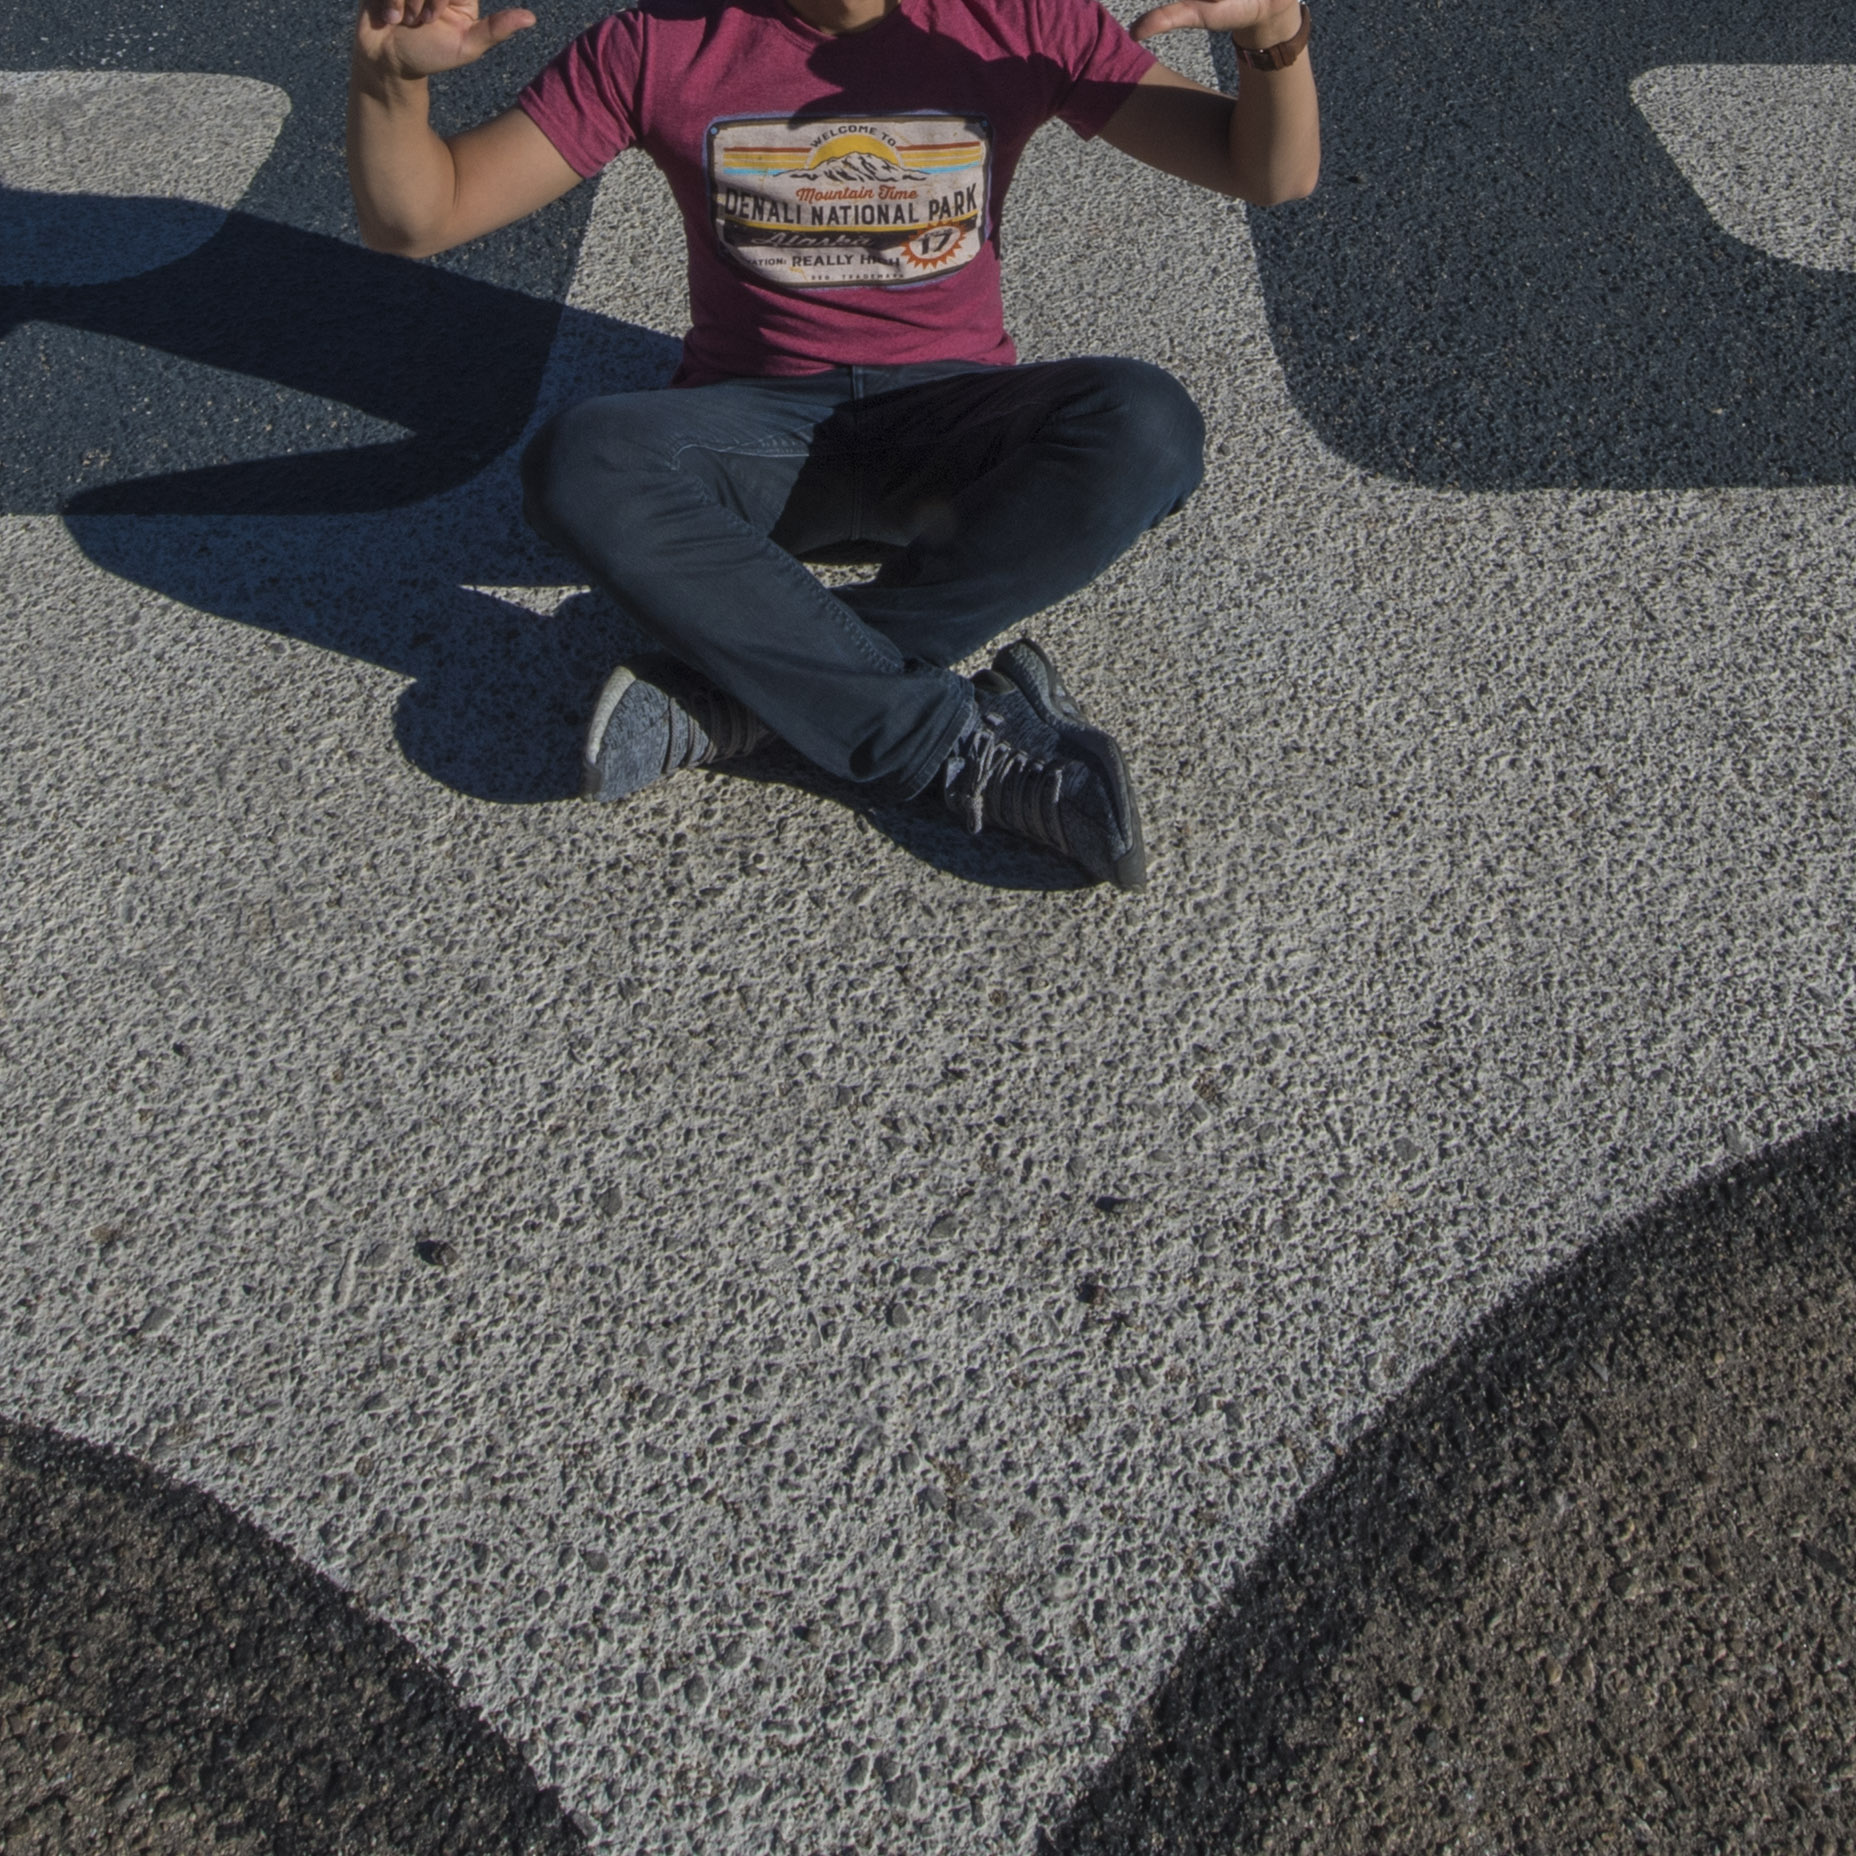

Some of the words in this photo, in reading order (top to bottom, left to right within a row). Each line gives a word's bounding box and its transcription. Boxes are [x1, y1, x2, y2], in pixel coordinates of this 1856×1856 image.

[810, 125, 878, 148] WELCOME
[882, 132, 897, 148] TO
[725, 188, 801, 225] DENALI
[812, 203, 920, 226] NATIONAL
[929, 183, 978, 221] PARK
[796, 185, 874, 205] Mountain
[878, 184, 919, 201] Time
[751, 231, 875, 247] Alaska
[915, 227, 954, 256] 17
[792, 254, 854, 268] REALLY
